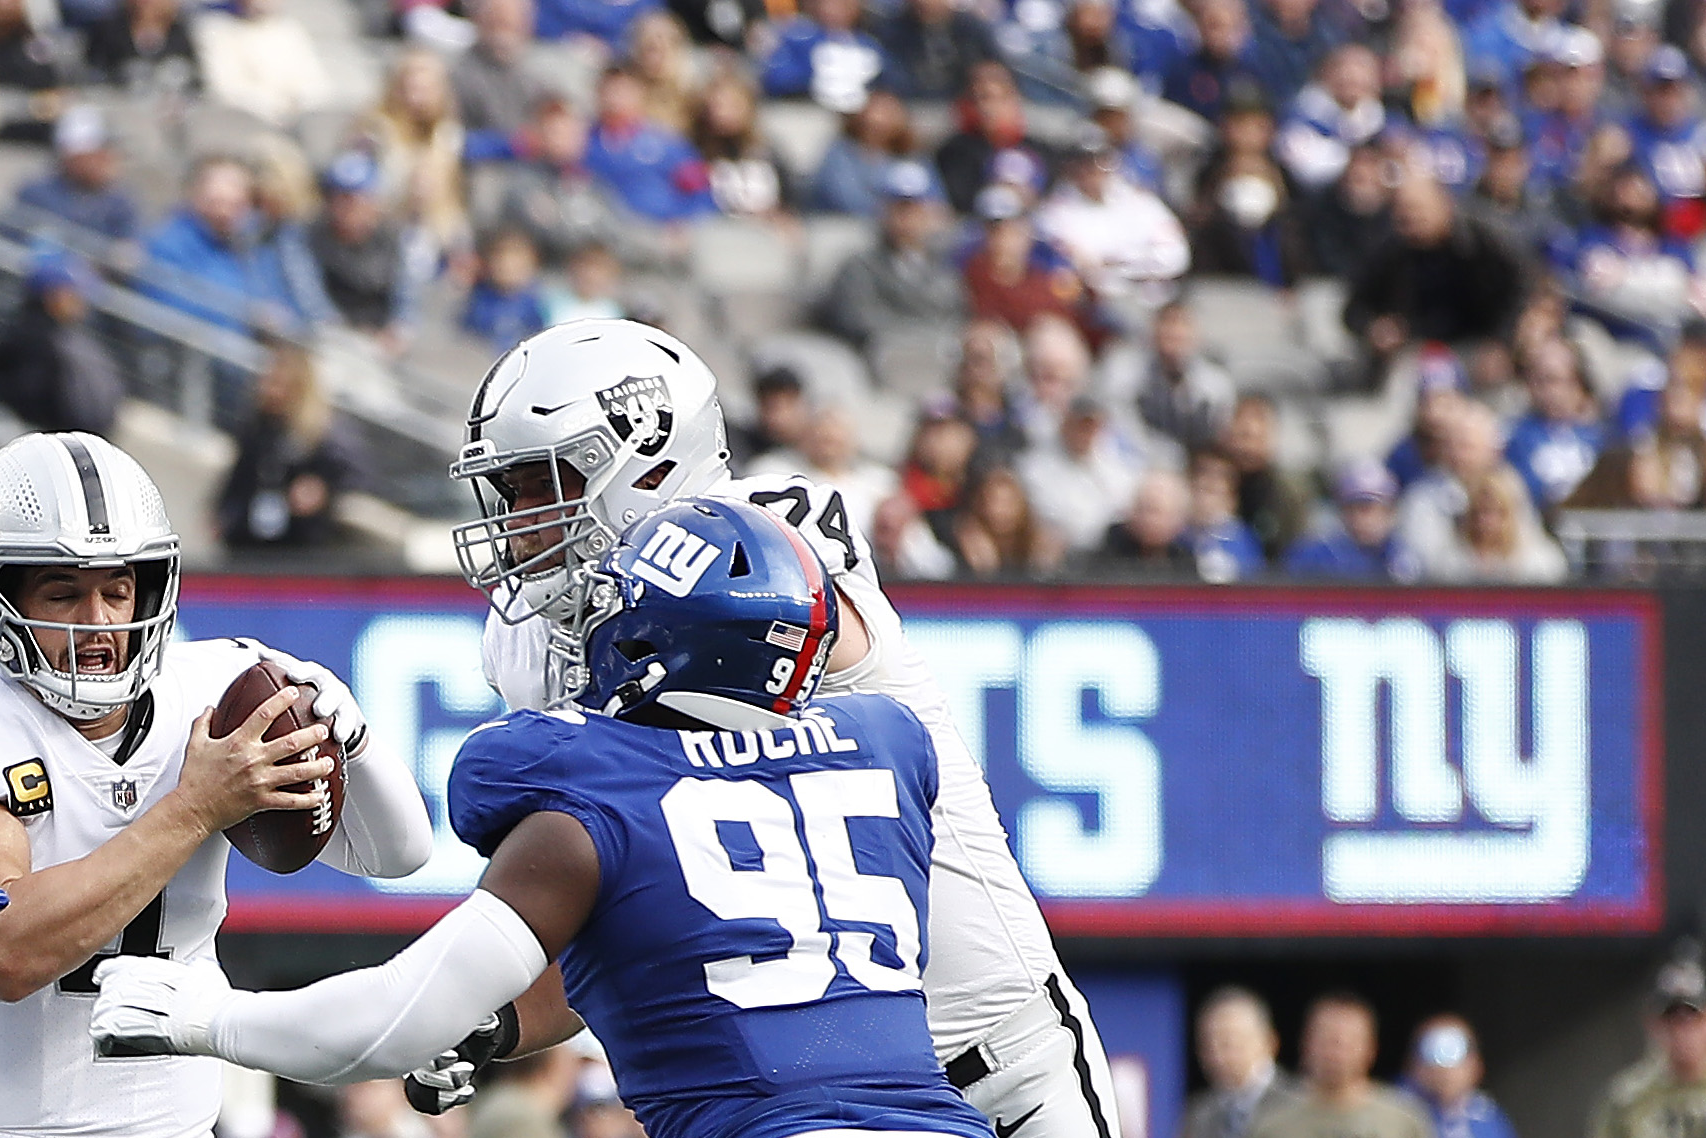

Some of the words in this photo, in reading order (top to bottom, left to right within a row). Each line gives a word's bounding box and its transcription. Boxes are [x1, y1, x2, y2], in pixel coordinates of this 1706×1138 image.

[602, 376, 662, 401] RAIDERS
[9, 761, 50, 803] C
[659, 768, 924, 1009] 95
